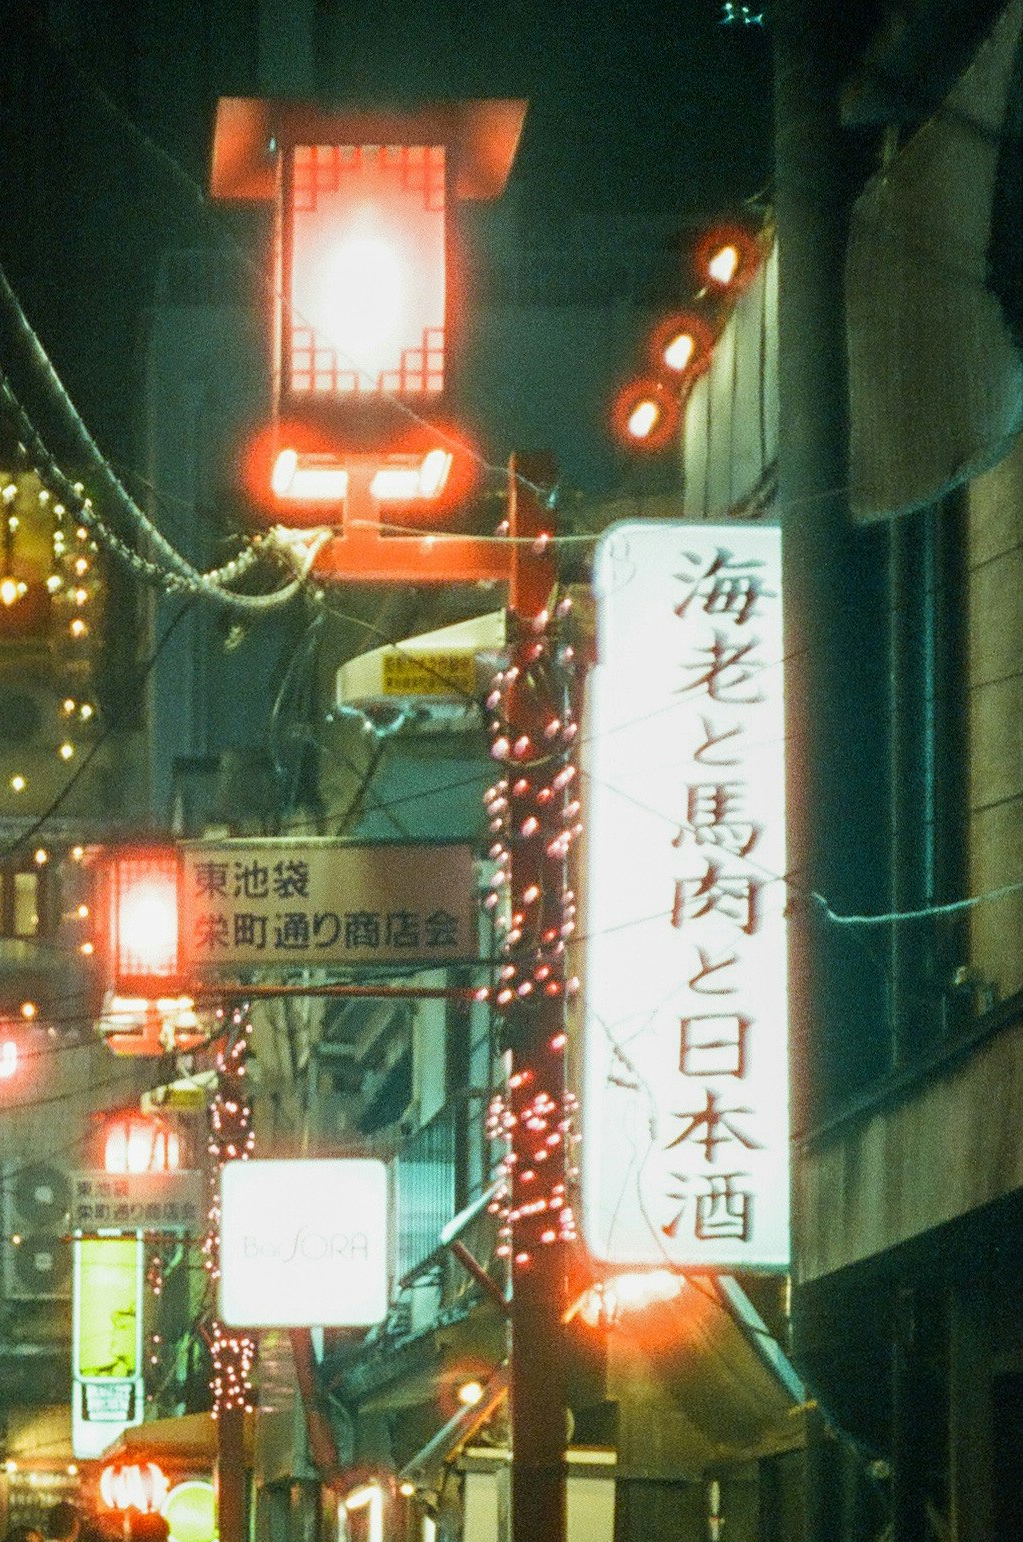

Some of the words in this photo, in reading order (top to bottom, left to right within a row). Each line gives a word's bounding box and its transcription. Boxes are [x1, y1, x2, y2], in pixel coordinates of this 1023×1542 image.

[194, 861, 310, 900] 東池袋
[662, 548, 777, 1243] 海老と馬肉と日本酒
[194, 910, 461, 950] 栄町通り商店会
